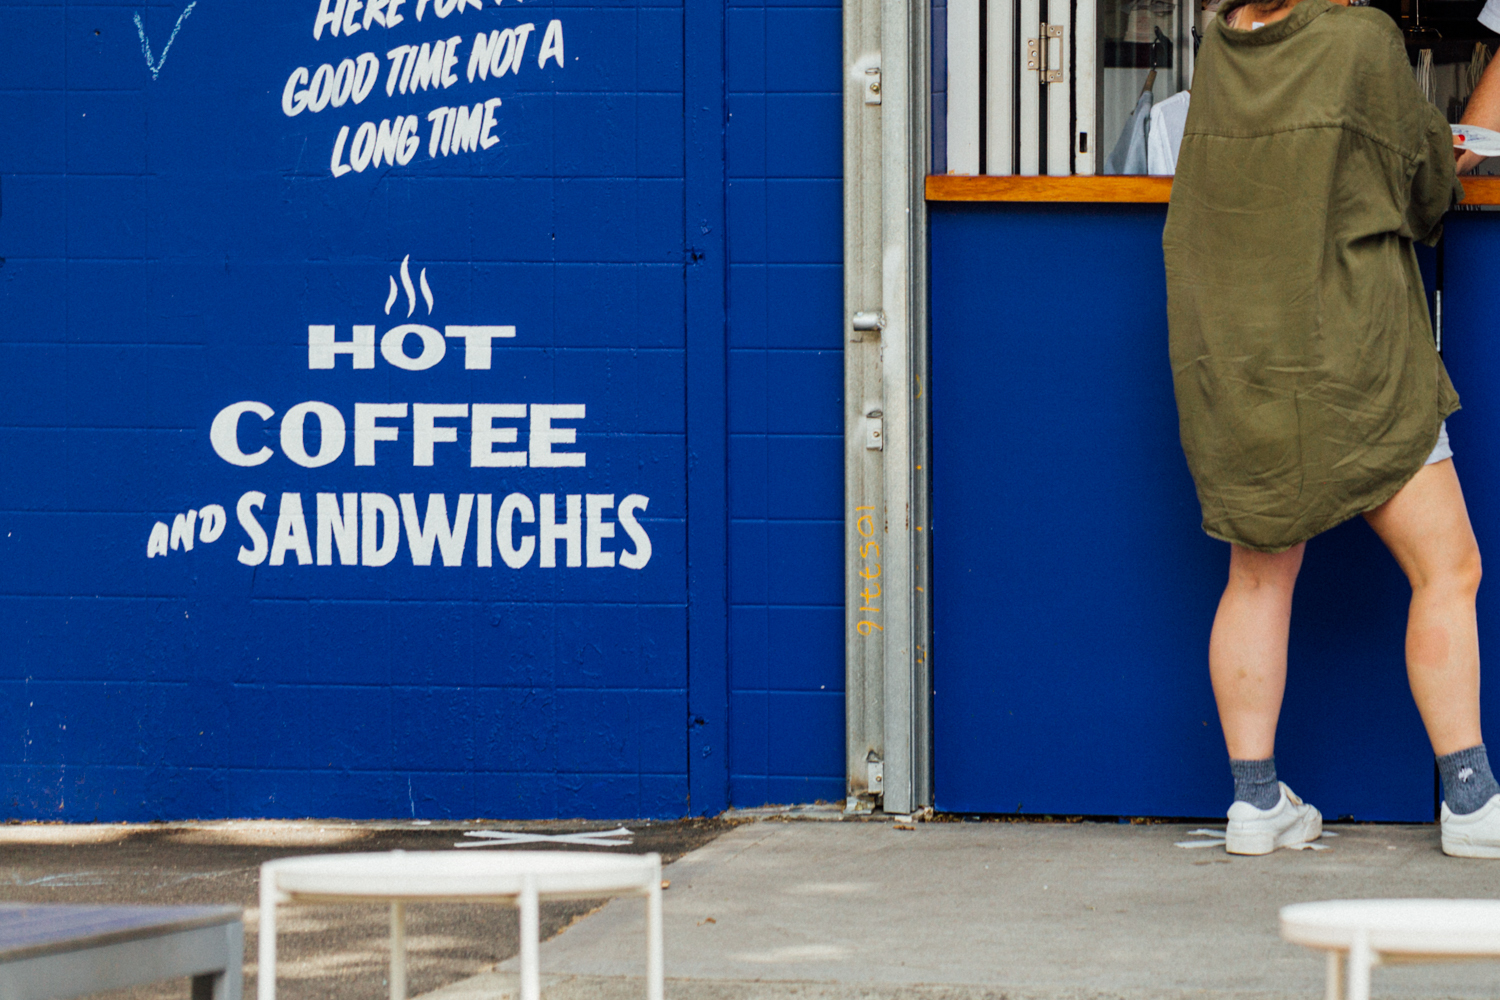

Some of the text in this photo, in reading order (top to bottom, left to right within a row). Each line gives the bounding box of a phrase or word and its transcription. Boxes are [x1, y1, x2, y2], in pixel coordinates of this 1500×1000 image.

[282, 19, 564, 117] GOOD TIME NOT A
[330, 97, 502, 177] LONG TIME
[308, 323, 516, 370] HOT
[210, 400, 586, 468] COFFEE
[147, 490, 653, 570] AND SANDWICHES
